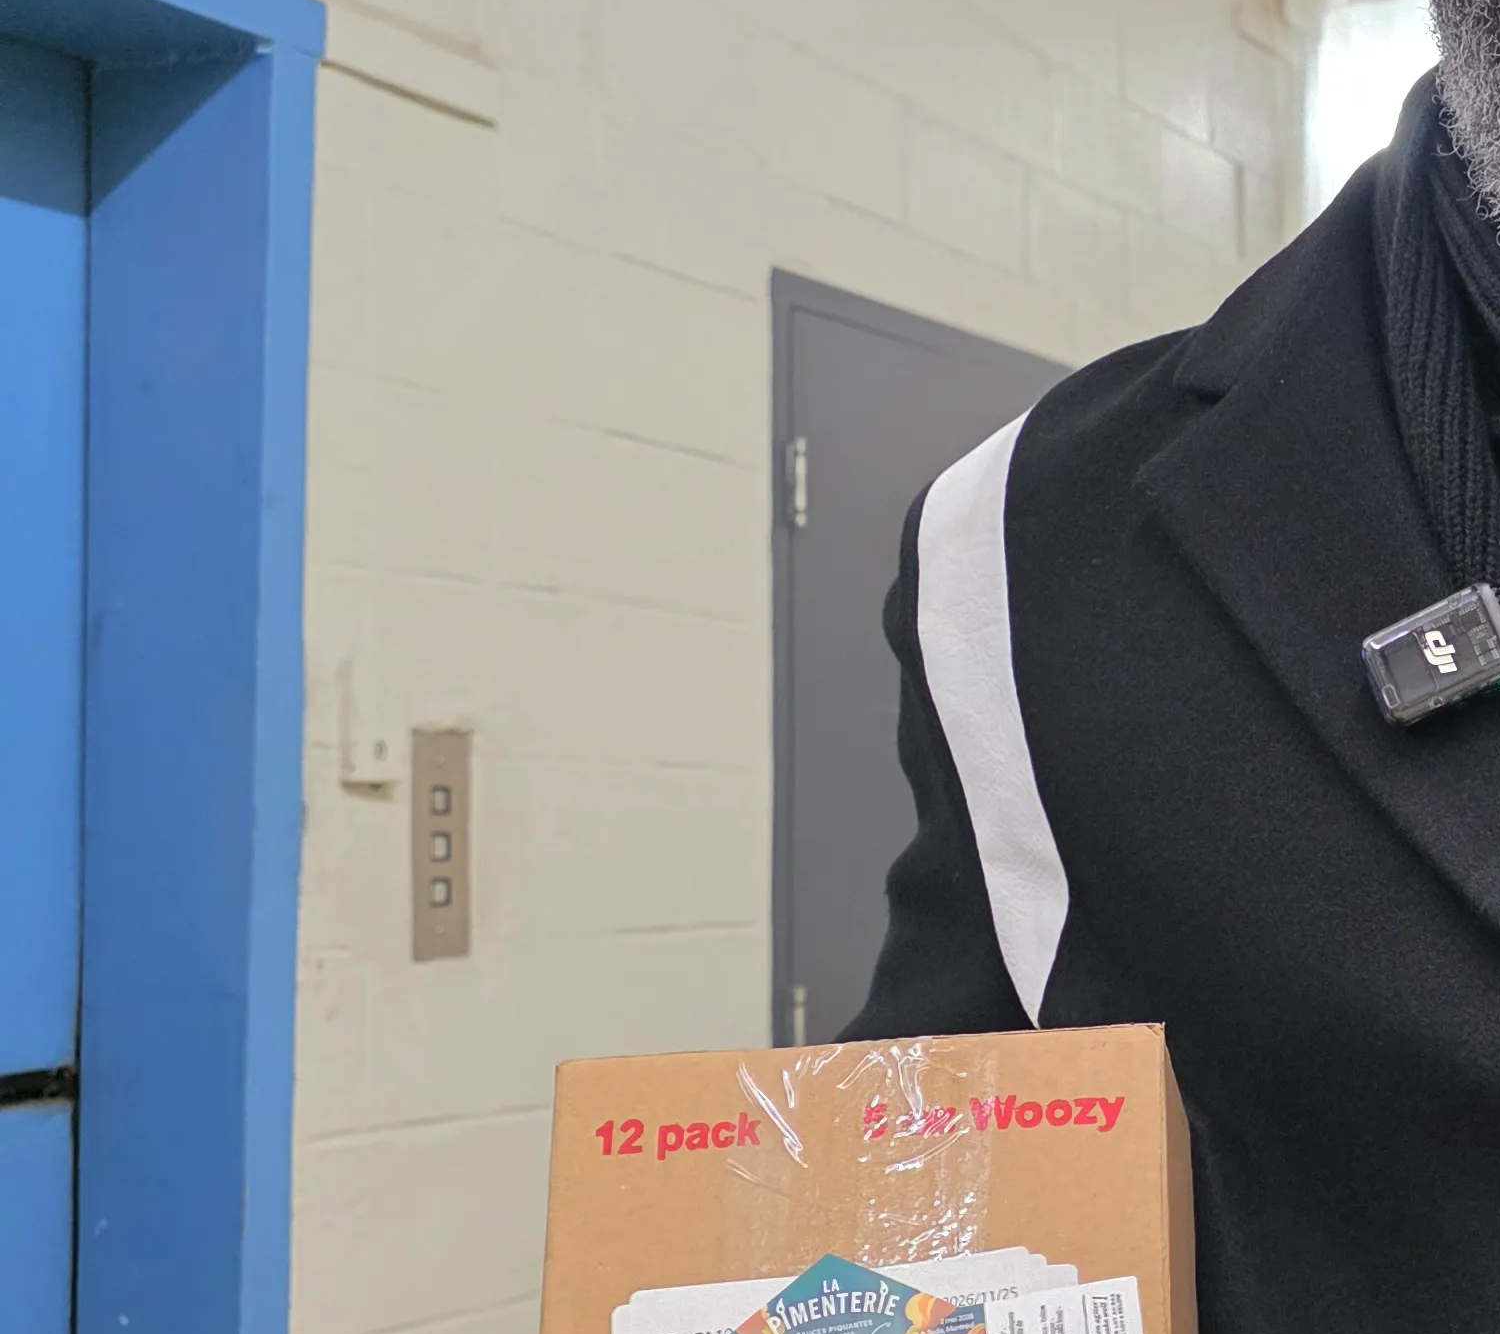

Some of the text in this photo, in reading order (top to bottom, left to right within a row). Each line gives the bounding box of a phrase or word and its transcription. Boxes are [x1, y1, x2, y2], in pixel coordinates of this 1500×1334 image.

[969, 1094, 1125, 1133] Woozy
[595, 1112, 761, 1160] 12 pack
[823, 1278, 839, 1293] LA
